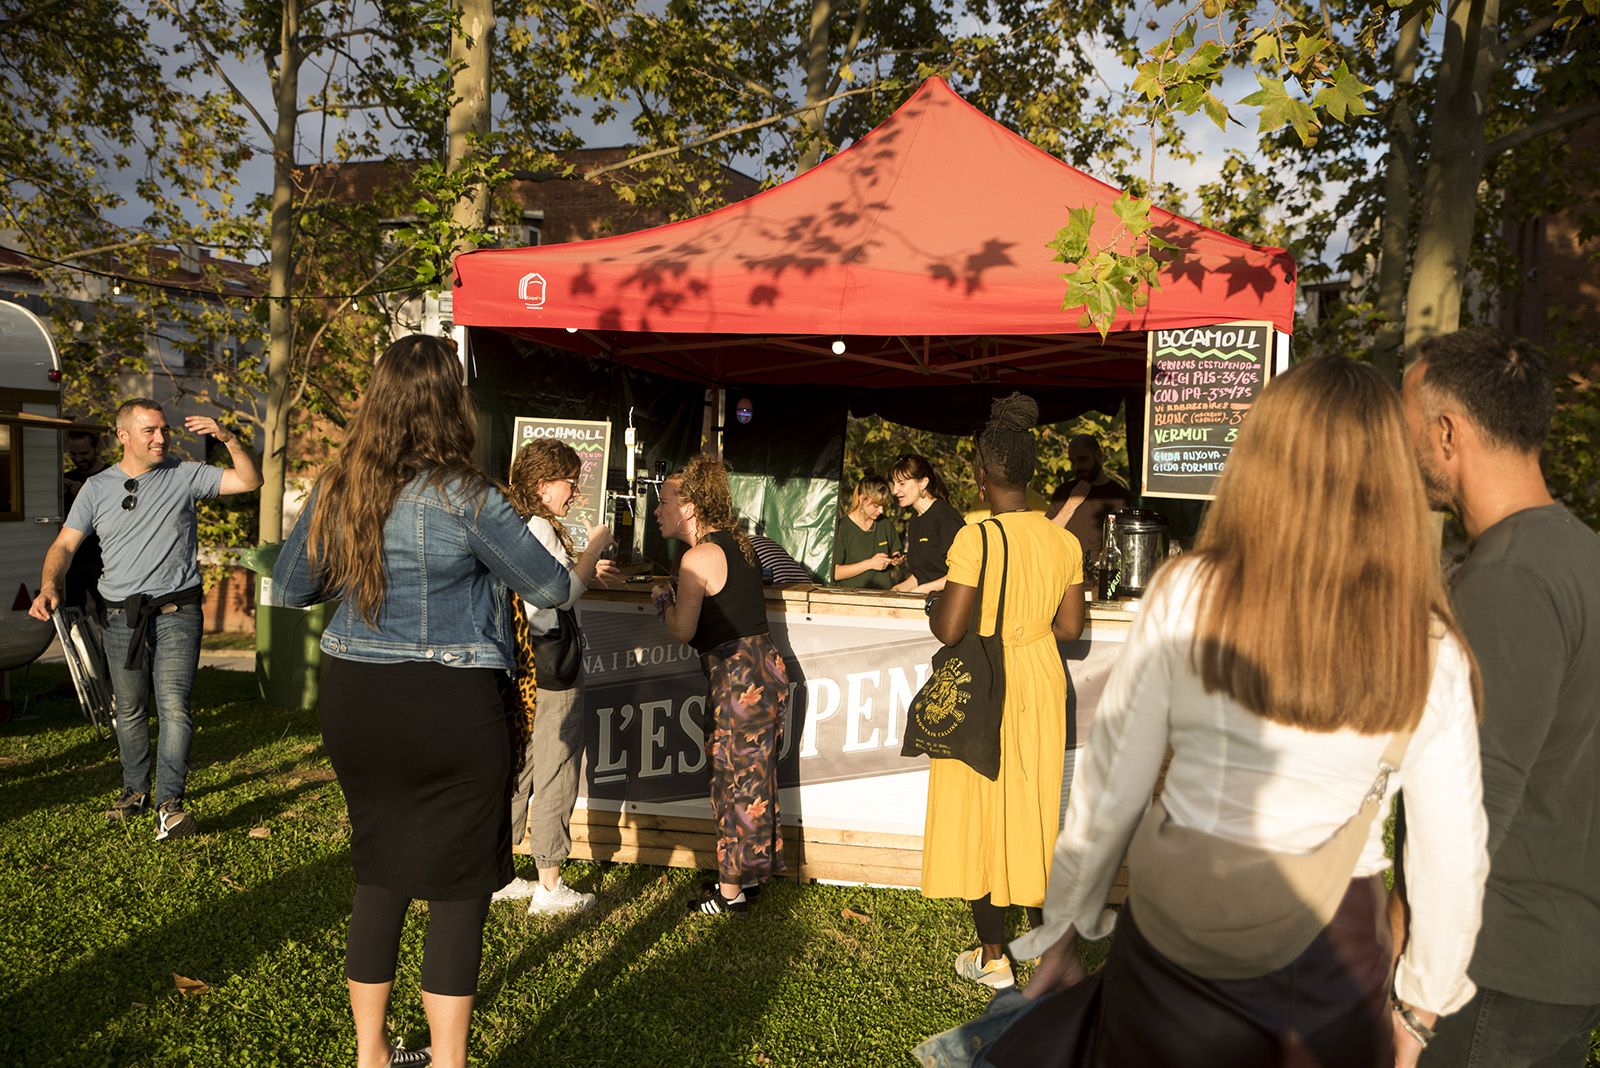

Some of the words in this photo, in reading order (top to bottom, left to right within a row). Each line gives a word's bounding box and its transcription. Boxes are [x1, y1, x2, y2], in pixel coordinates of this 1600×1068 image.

[1157, 328, 1260, 349] BOCAMOLL
[1153, 371, 1189, 387] CZECH
[1153, 388, 1179, 403] COLD
[1154, 412, 1189, 426] BLANC
[523, 425, 604, 440] BOCAMOLL
[1154, 428, 1214, 444] VERMUT
[1153, 451, 1181, 462] GILDA
[1183, 450, 1221, 461] ANXOVA
[1153, 463, 1179, 472] GILDA
[611, 652, 619, 671] I
